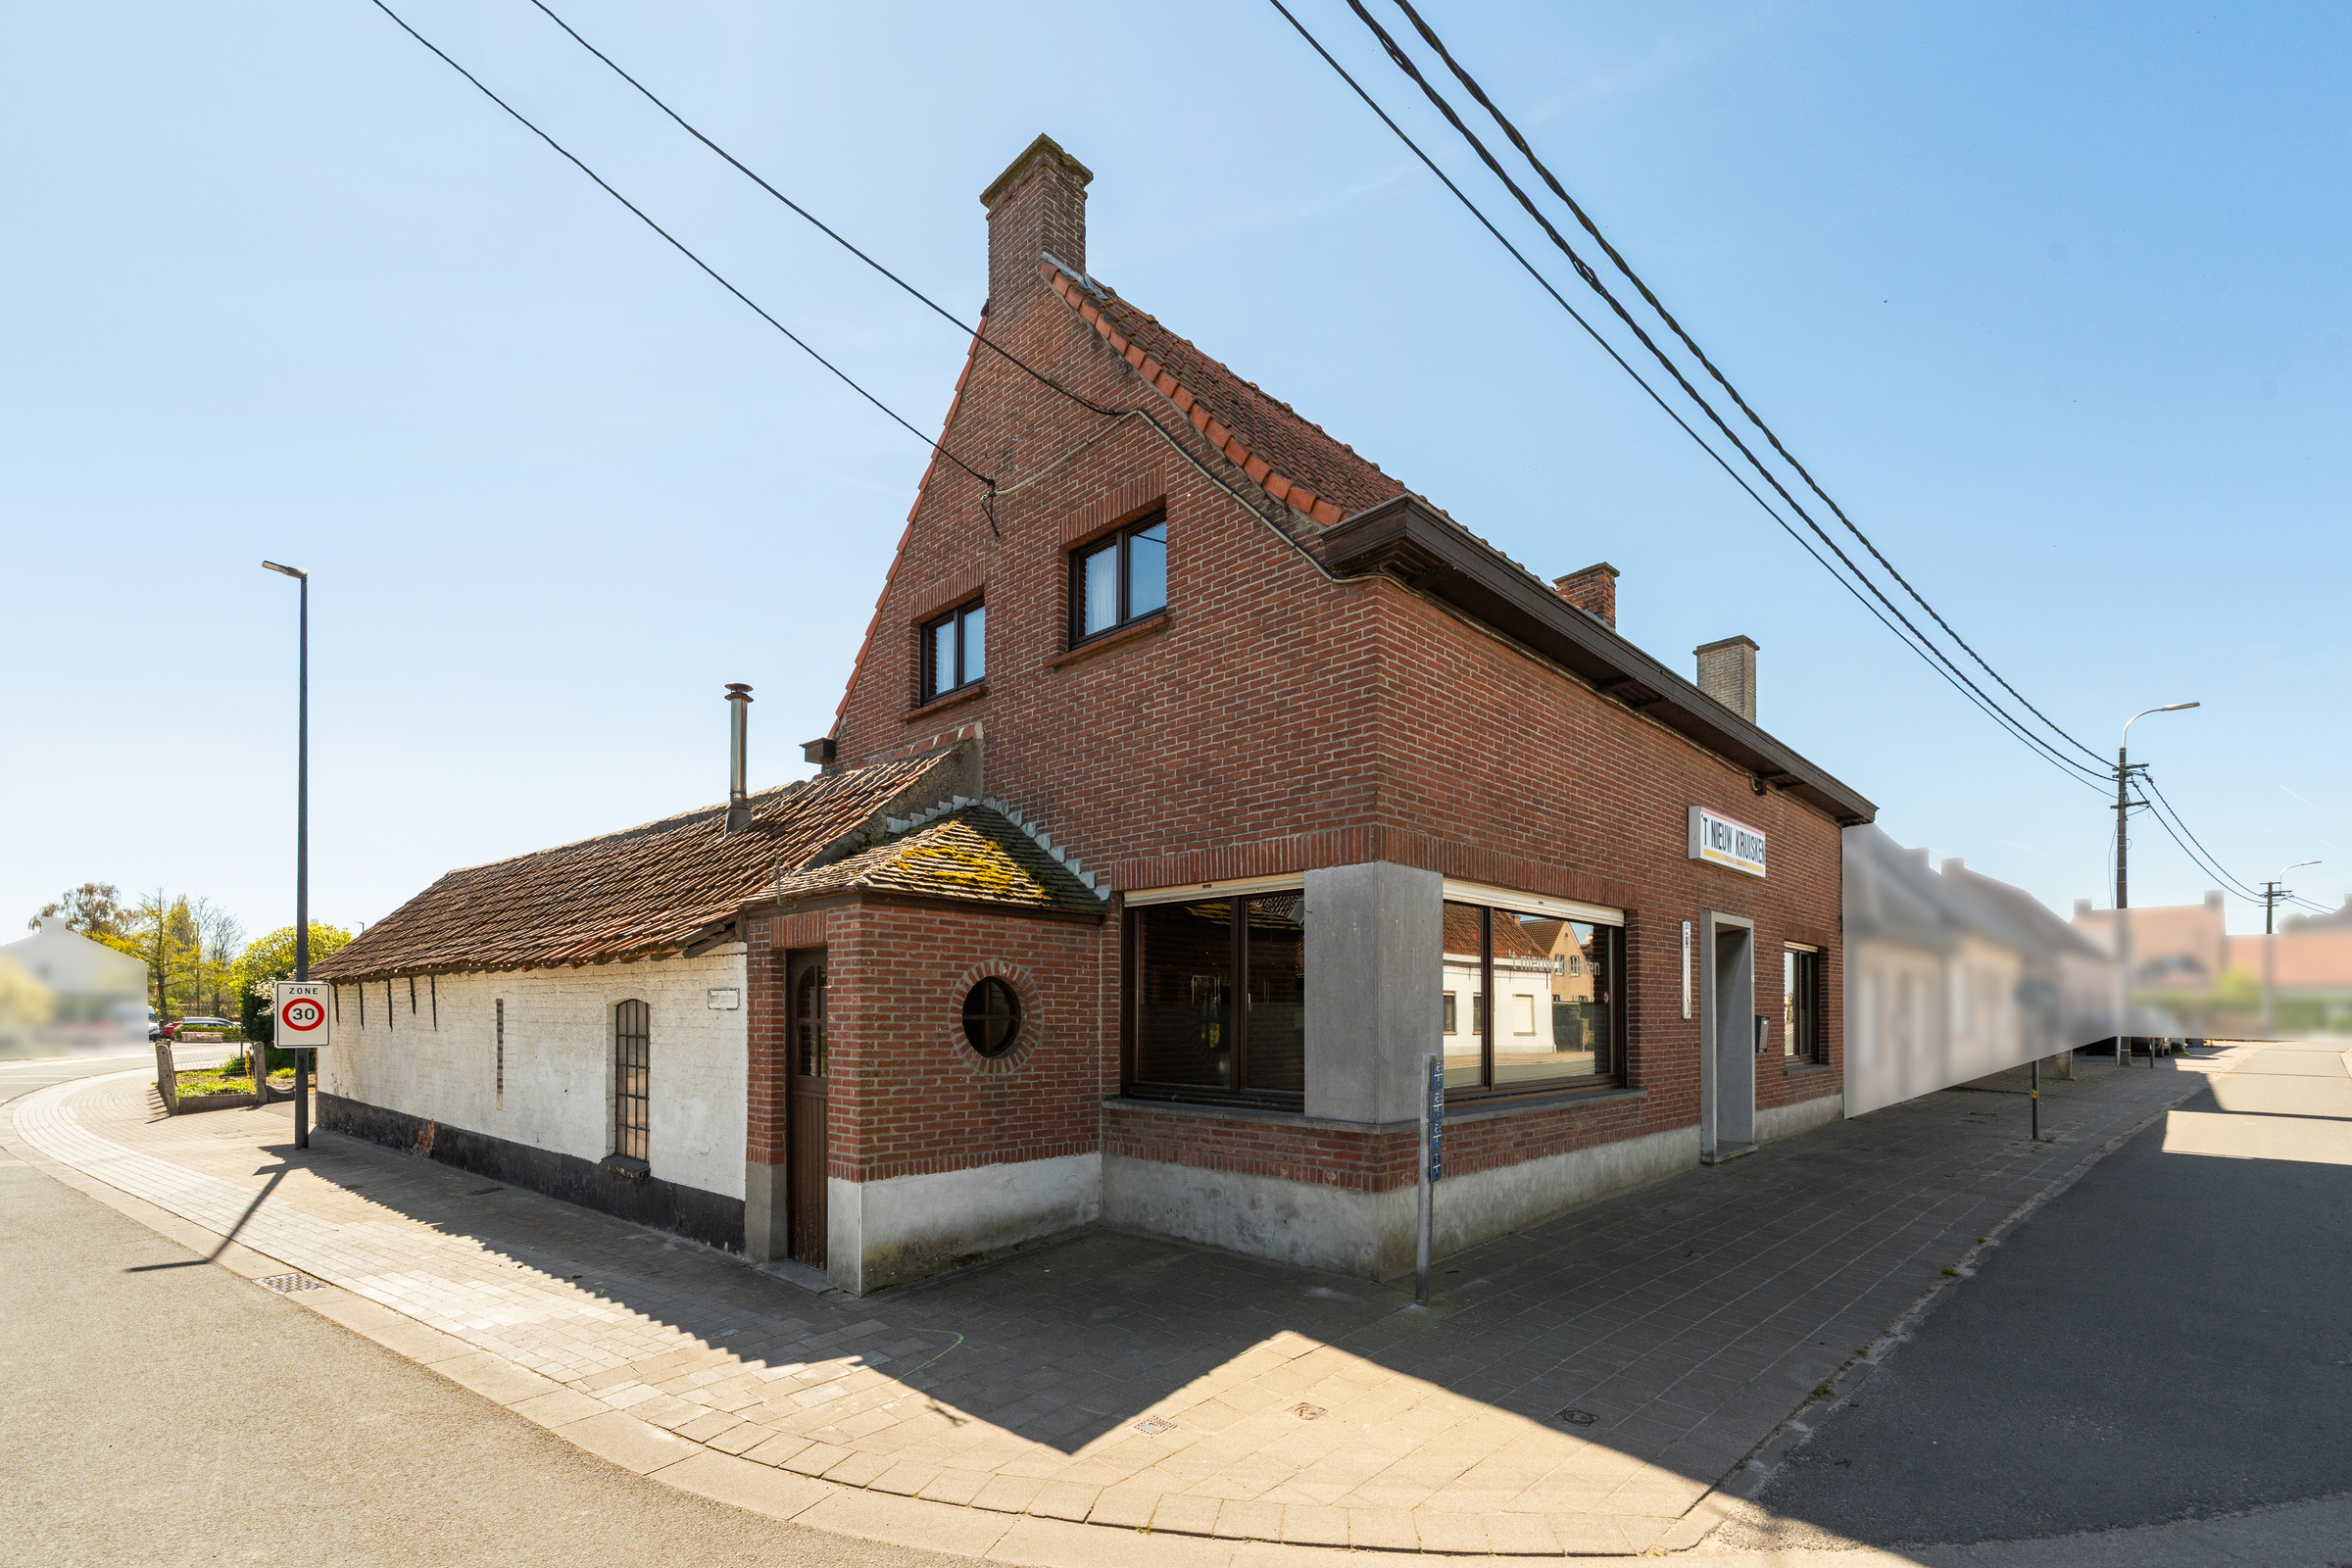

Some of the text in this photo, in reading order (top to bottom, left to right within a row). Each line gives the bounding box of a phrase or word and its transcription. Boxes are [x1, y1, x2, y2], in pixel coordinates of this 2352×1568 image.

[1710, 819, 1733, 854] NIEUW
[1736, 829, 1766, 865] KRUISKEN
[1520, 950, 1555, 973] nieuw
[292, 1007, 316, 1020] 30
